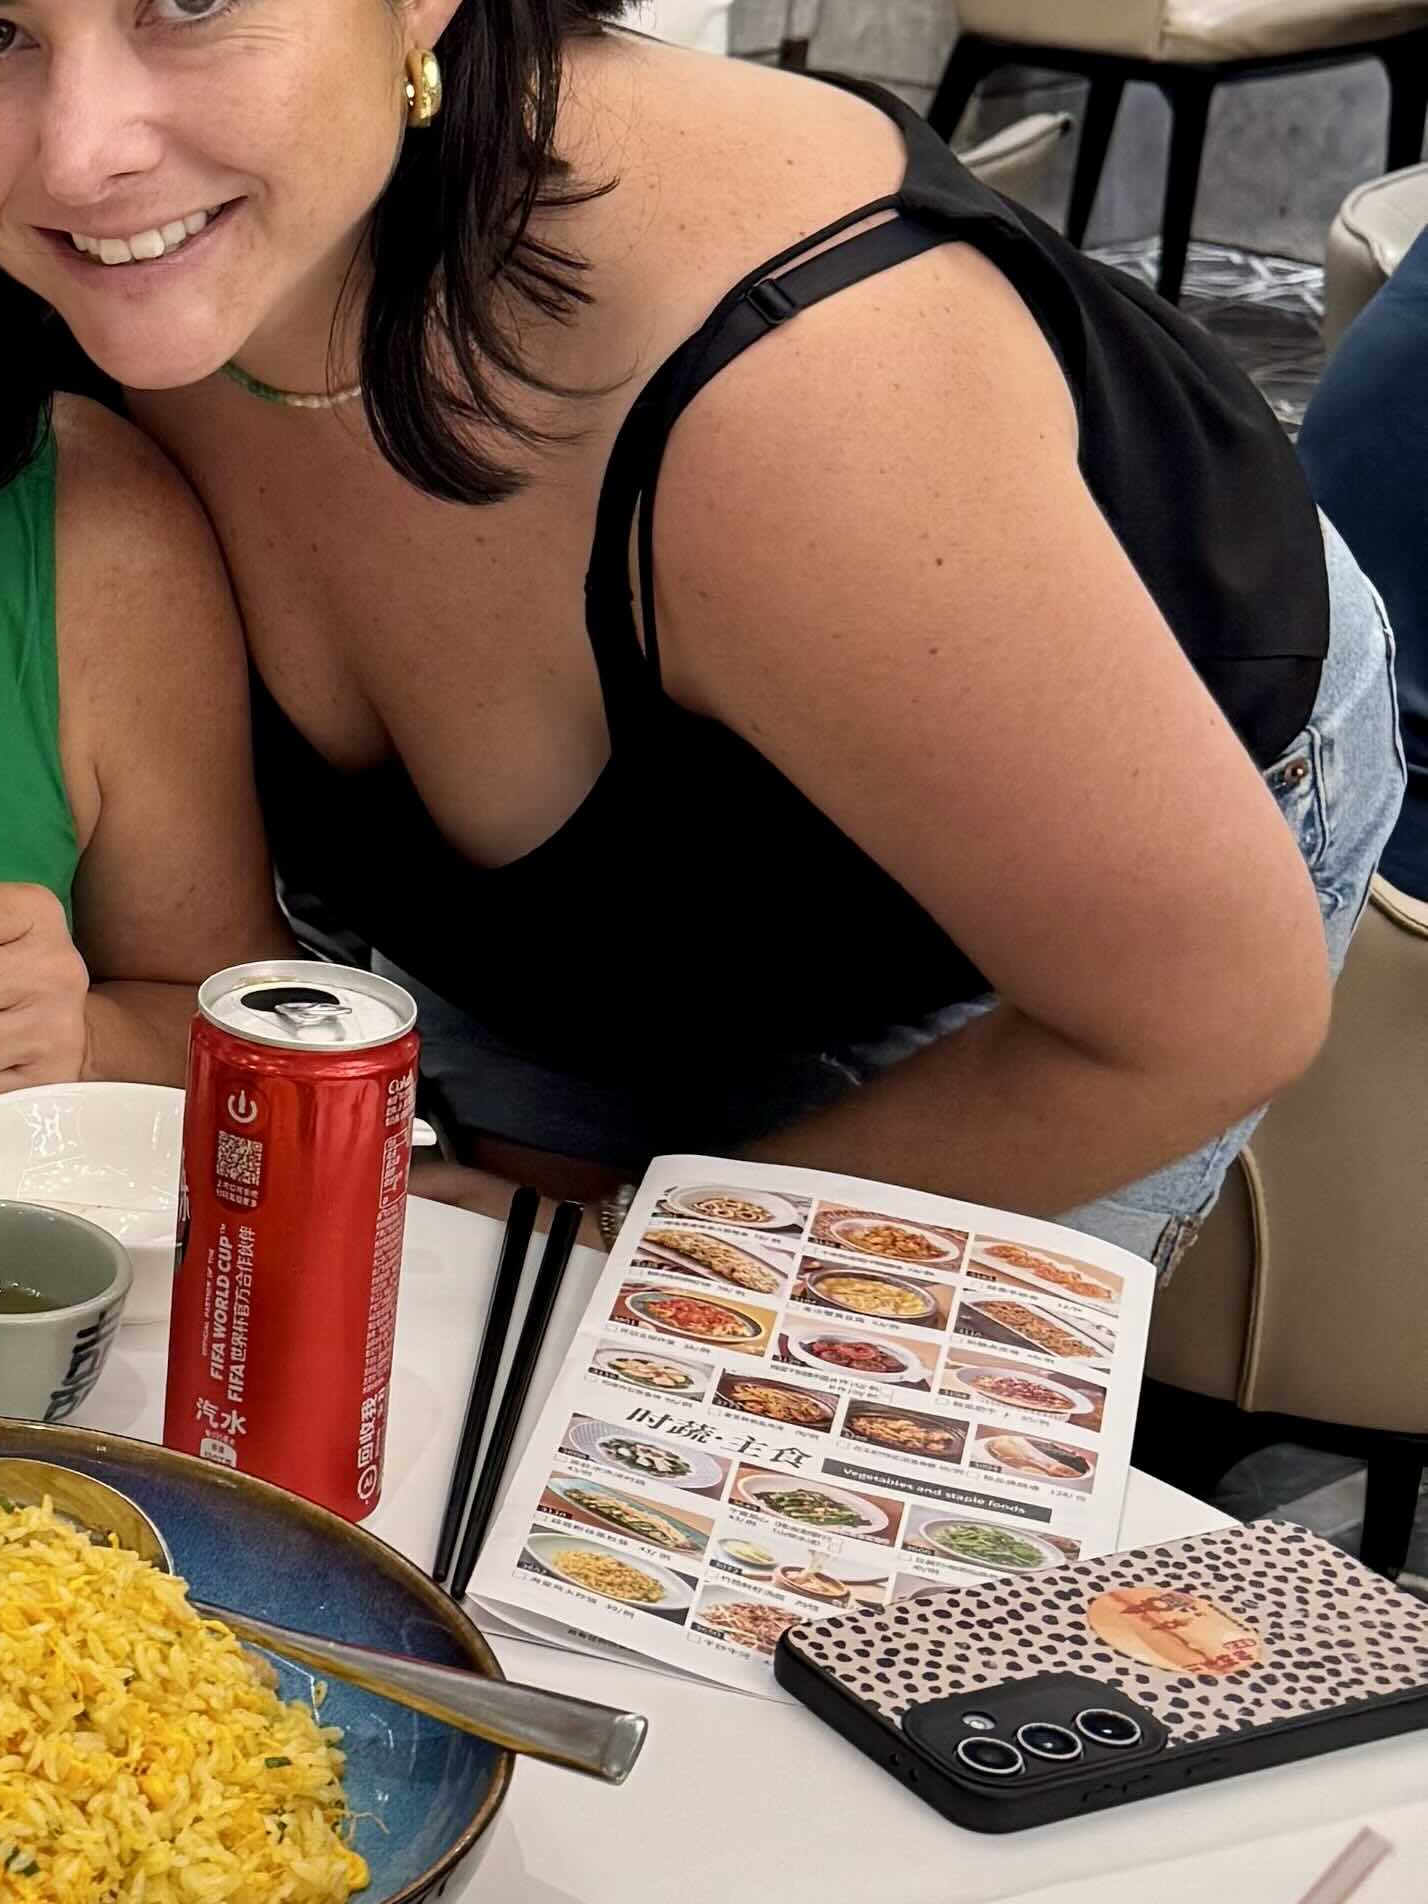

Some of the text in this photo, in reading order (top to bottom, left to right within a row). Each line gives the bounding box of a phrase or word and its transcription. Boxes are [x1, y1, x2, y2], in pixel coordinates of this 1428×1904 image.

[212, 1275, 230, 1342] WORLD
[210, 1344, 226, 1380] FIFA
[227, 1364, 245, 1402] FIFA
[195, 1397, 248, 1436] 汽水
[843, 1467, 914, 1491] Vegetables
[945, 1490, 986, 1506] staple
